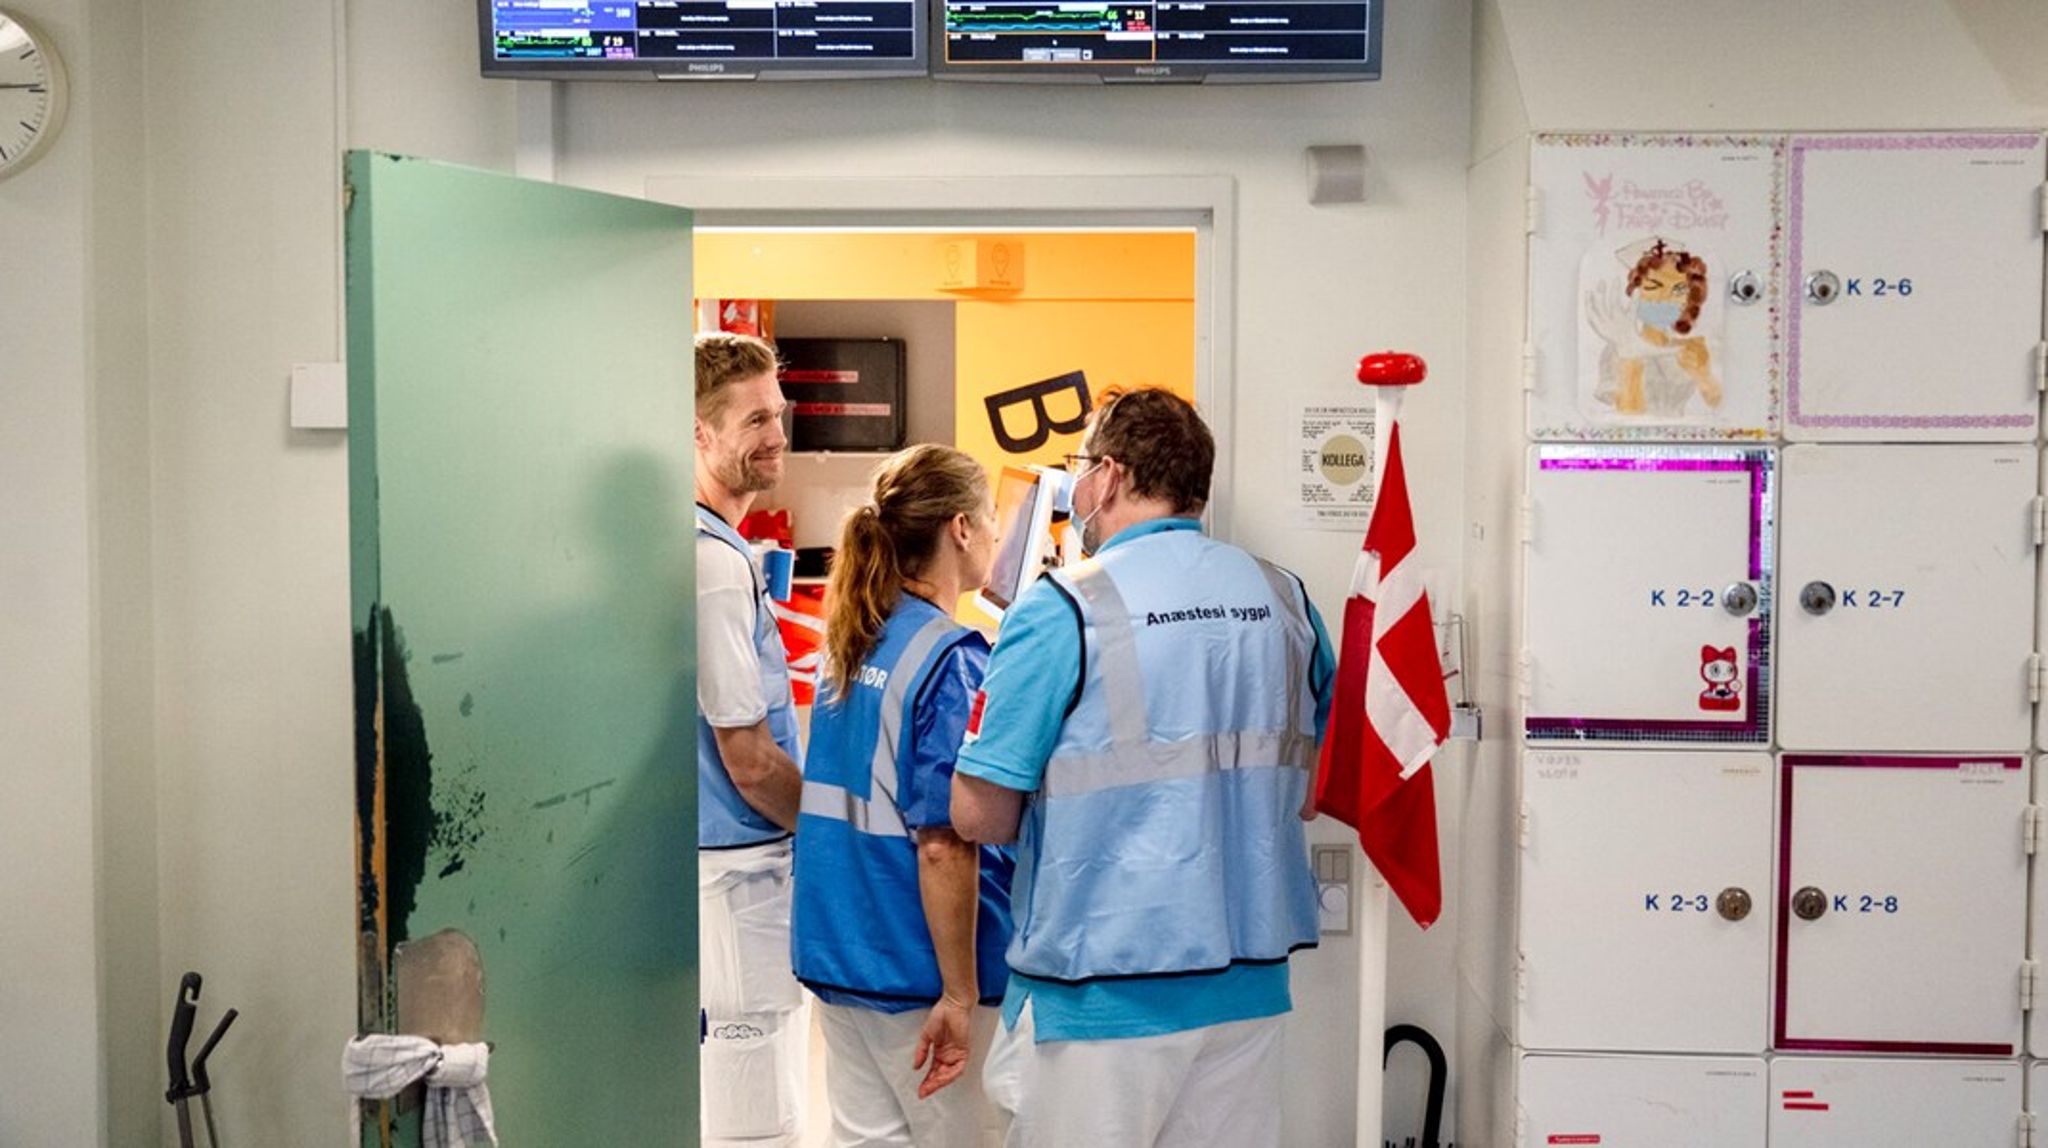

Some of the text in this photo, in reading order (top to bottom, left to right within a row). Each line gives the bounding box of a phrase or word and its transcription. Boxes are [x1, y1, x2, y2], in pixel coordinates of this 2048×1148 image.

[688, 63, 724, 72] PHILIPS
[1135, 66, 1171, 75] PHILIPS
[1846, 278, 1913, 297] K 2-6
[984, 370, 1093, 454] B
[1321, 453, 1366, 468] KOLLEGA
[1651, 589, 1715, 607] K 2-2
[1842, 590, 1906, 607] K 2-7
[1146, 604, 1271, 626] Anæstesi sygpl
[1645, 894, 1709, 912] K 2-3
[1833, 895, 1899, 913] K 2-8
